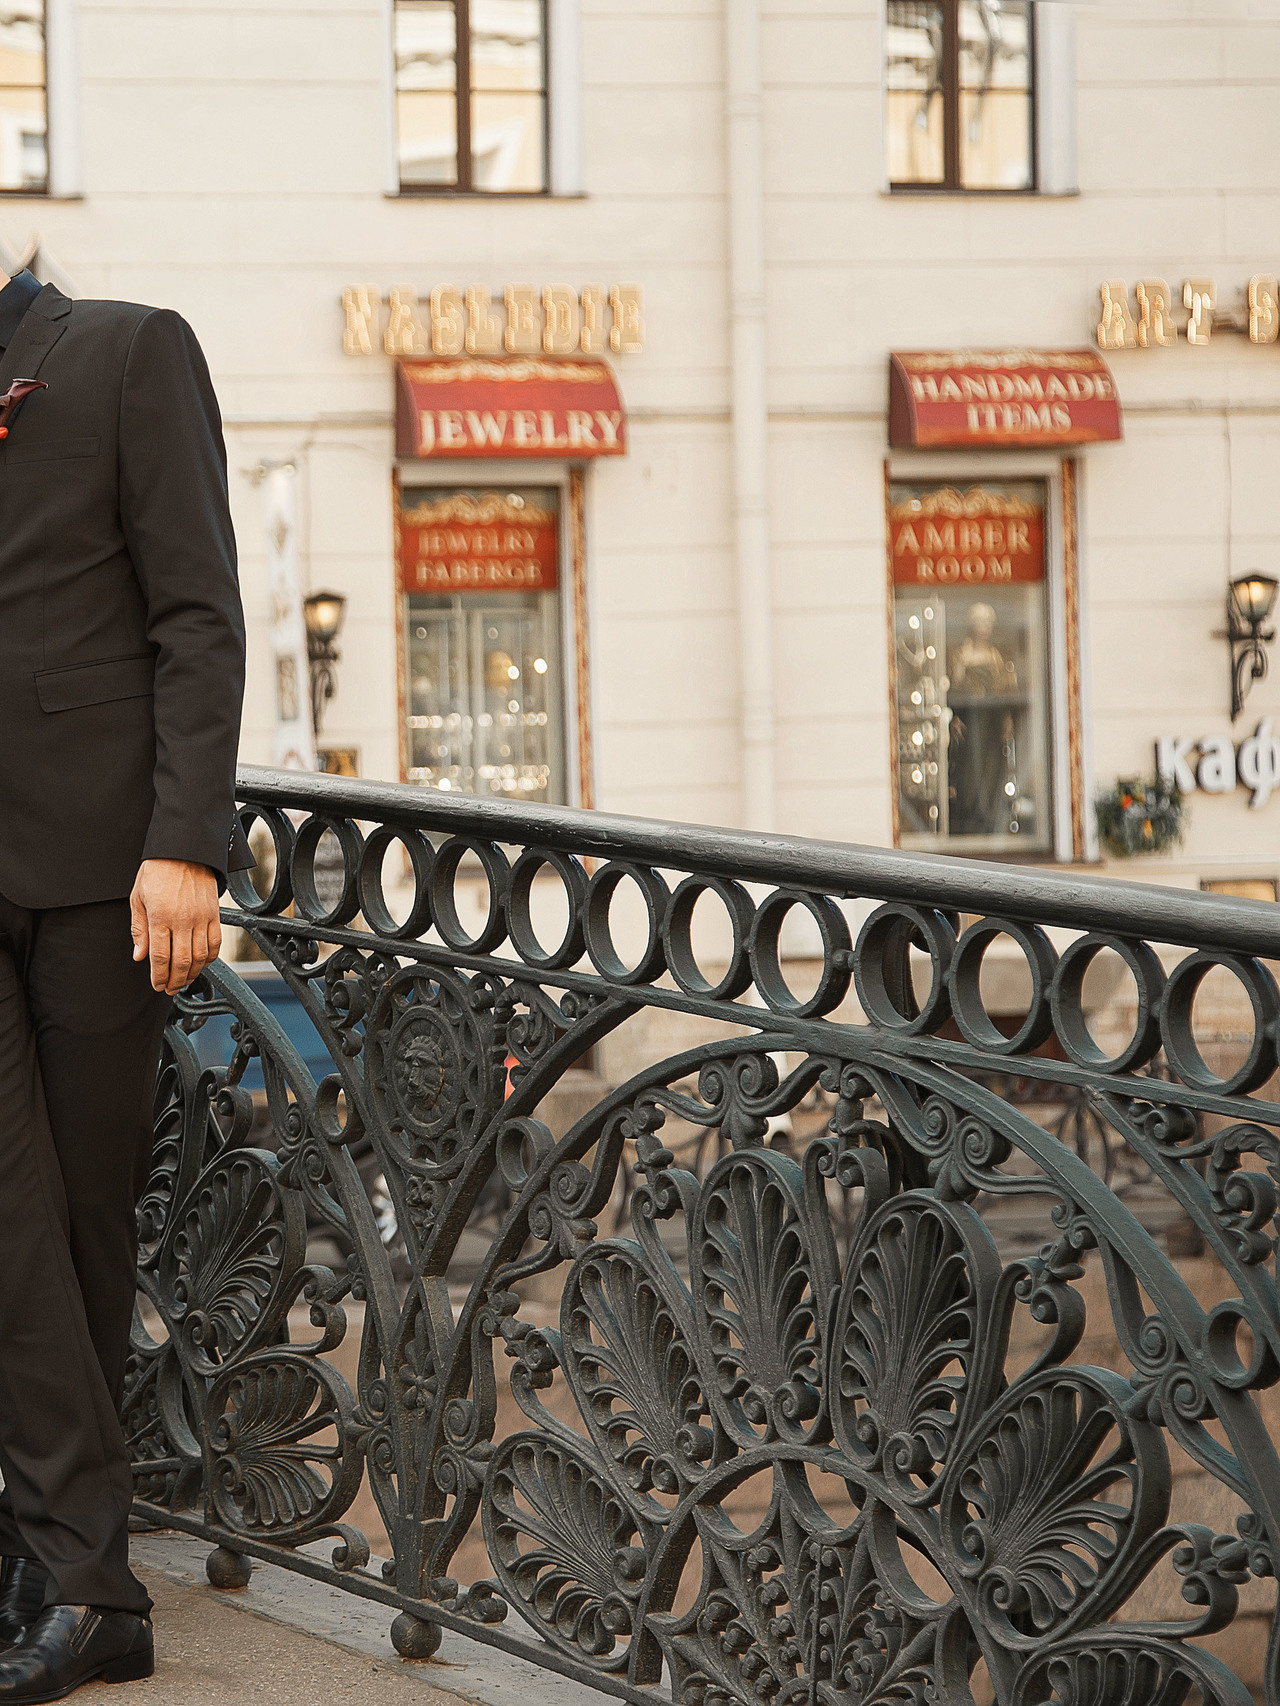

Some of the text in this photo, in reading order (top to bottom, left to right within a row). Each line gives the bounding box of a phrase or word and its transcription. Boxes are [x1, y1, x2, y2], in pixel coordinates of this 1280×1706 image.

[341, 282, 645, 355] NASLEDIE
[910, 372, 1114, 402] HANDMADE
[419, 408, 623, 455] JEWELRY
[966, 402, 1073, 435] ITEMS
[894, 519, 1033, 556] AMBER
[916, 555, 1013, 585] ROOM
